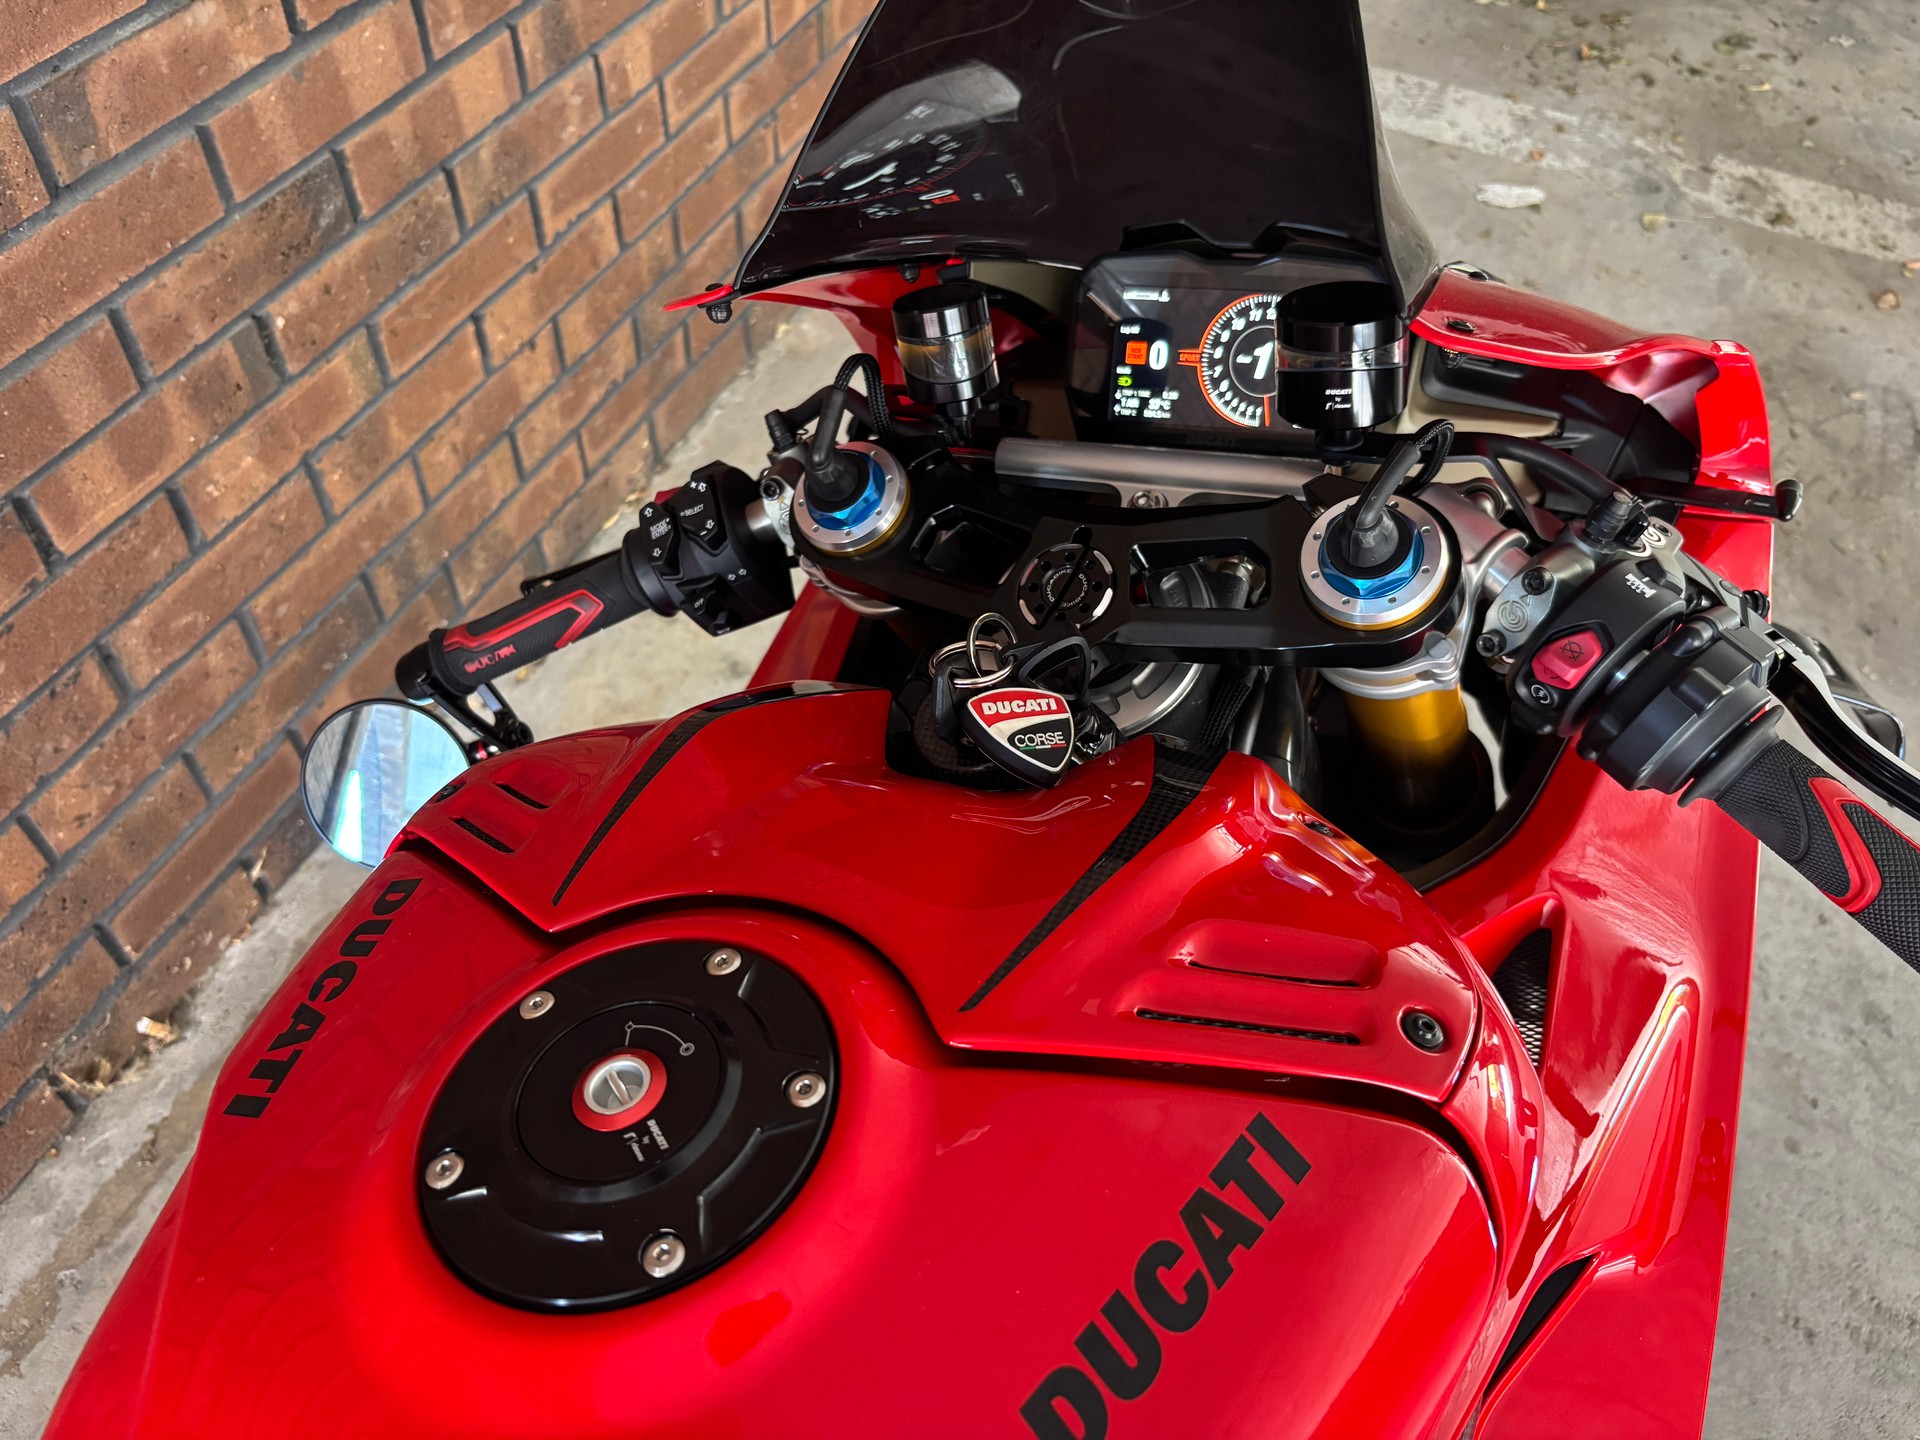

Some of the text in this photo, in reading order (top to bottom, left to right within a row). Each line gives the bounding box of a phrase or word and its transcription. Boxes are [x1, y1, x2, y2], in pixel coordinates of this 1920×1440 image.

[1149, 339, 1169, 371] 0
[1179, 352, 1201, 362] SPORT
[685, 503, 705, 516] SELECT
[650, 520, 667, 532] MODE
[651, 527, 669, 540] ENTER
[694, 597, 704, 608] OFF
[981, 697, 1058, 716] DUCATI
[1014, 731, 1066, 748] CORSE
[222, 878, 424, 1119] DUCATI
[646, 1118, 670, 1150] DUCATI
[1019, 1111, 1313, 1440] DUCATI
